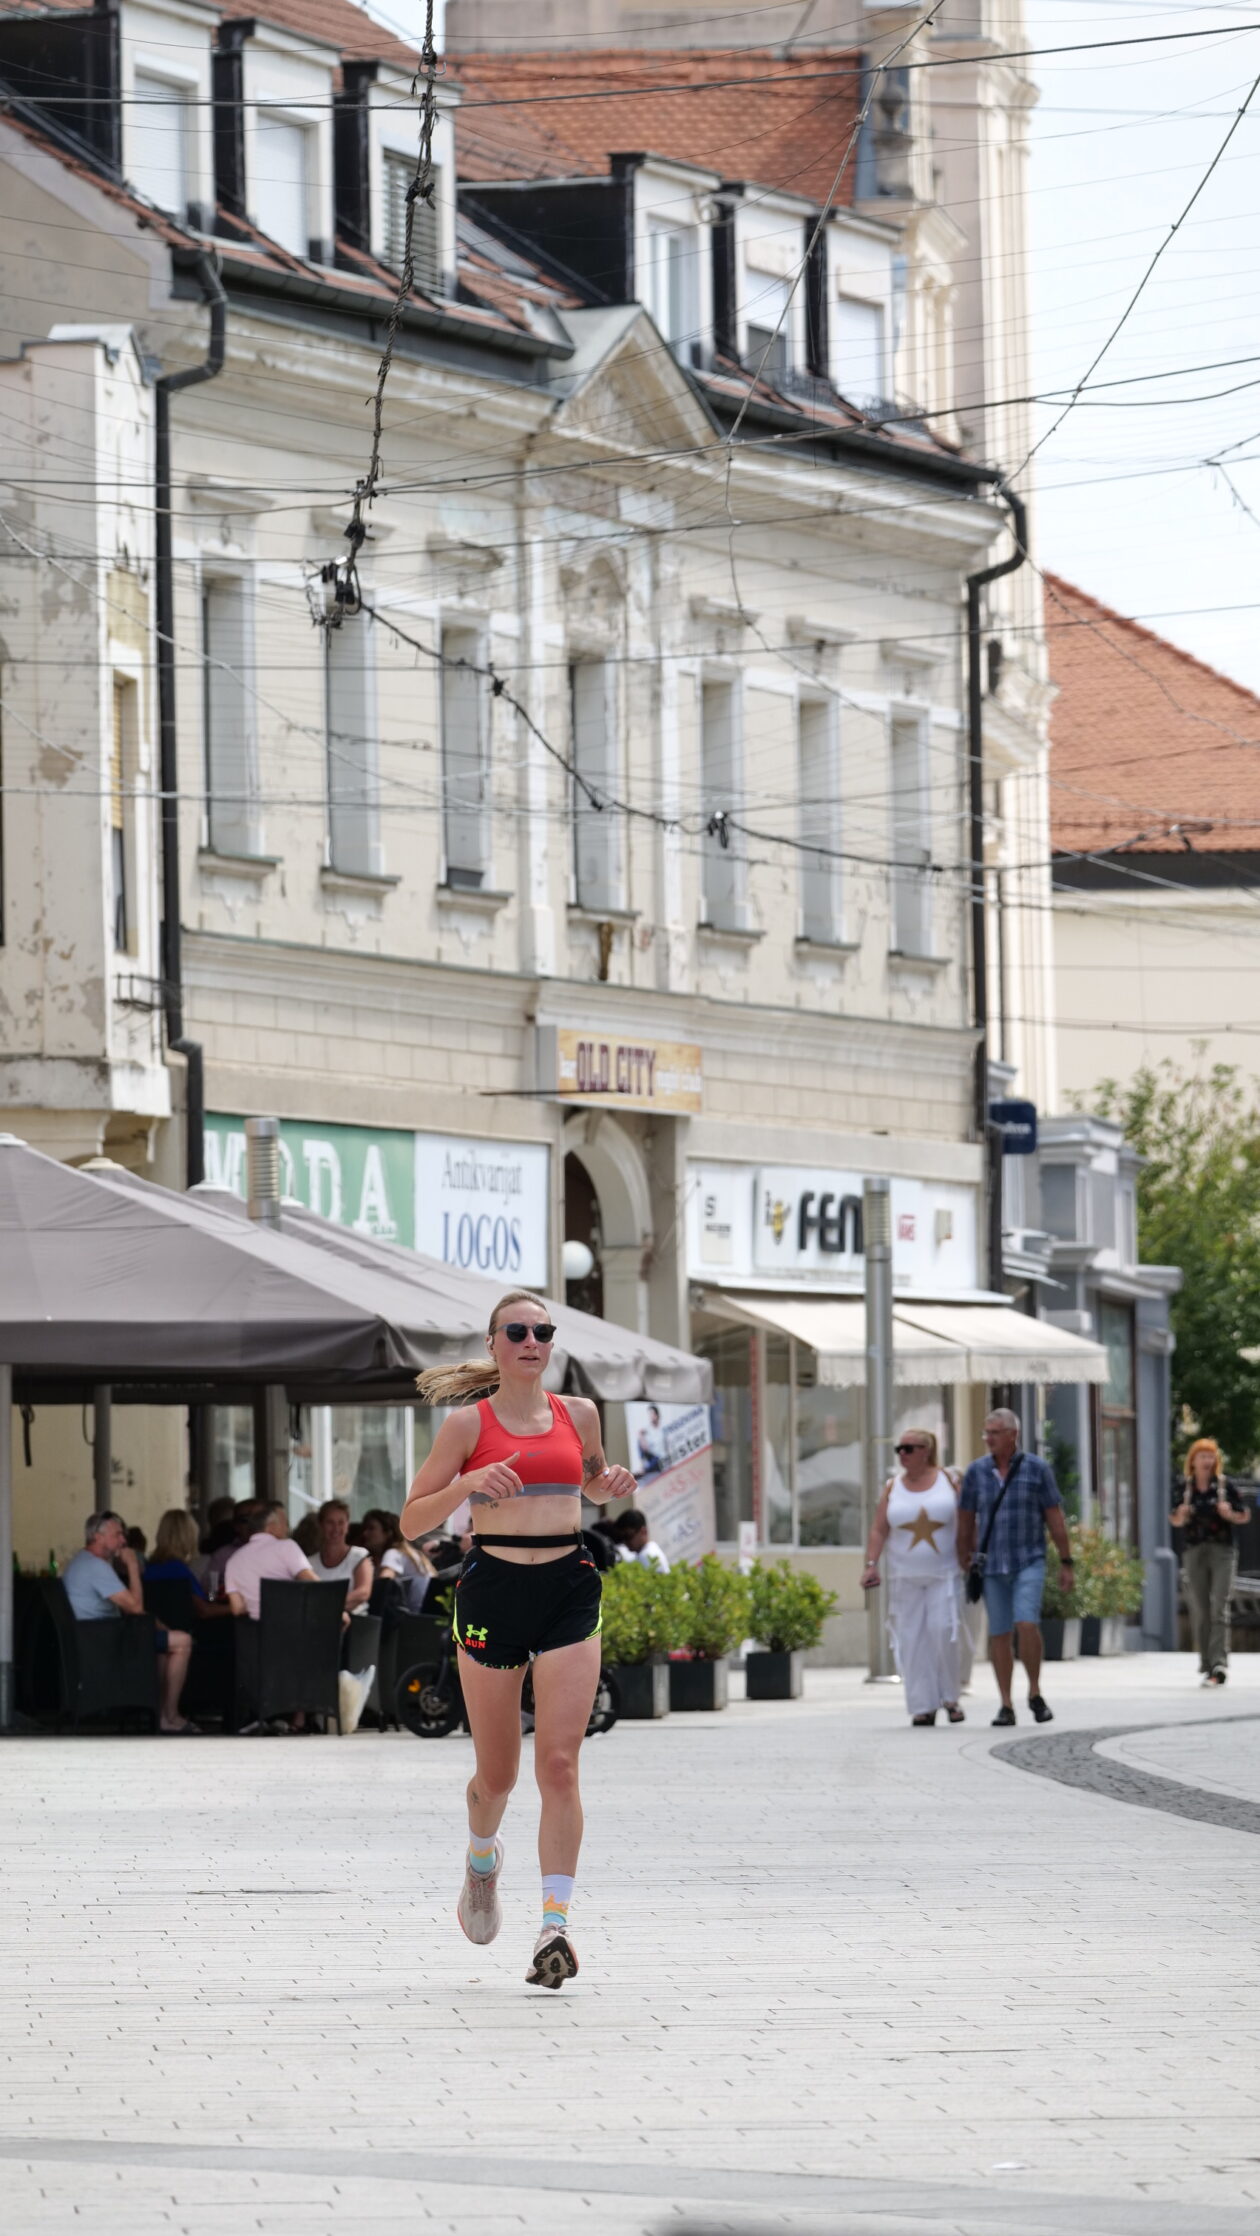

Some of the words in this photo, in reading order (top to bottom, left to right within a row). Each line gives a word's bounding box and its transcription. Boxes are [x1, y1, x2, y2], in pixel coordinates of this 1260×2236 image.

[576, 1041, 610, 1093] OLD
[615, 1045, 657, 1097] CITY
[443, 1211, 523, 1273] LOGOS
[798, 1190, 865, 1255] FEN
[465, 1638, 486, 1648] RUN
